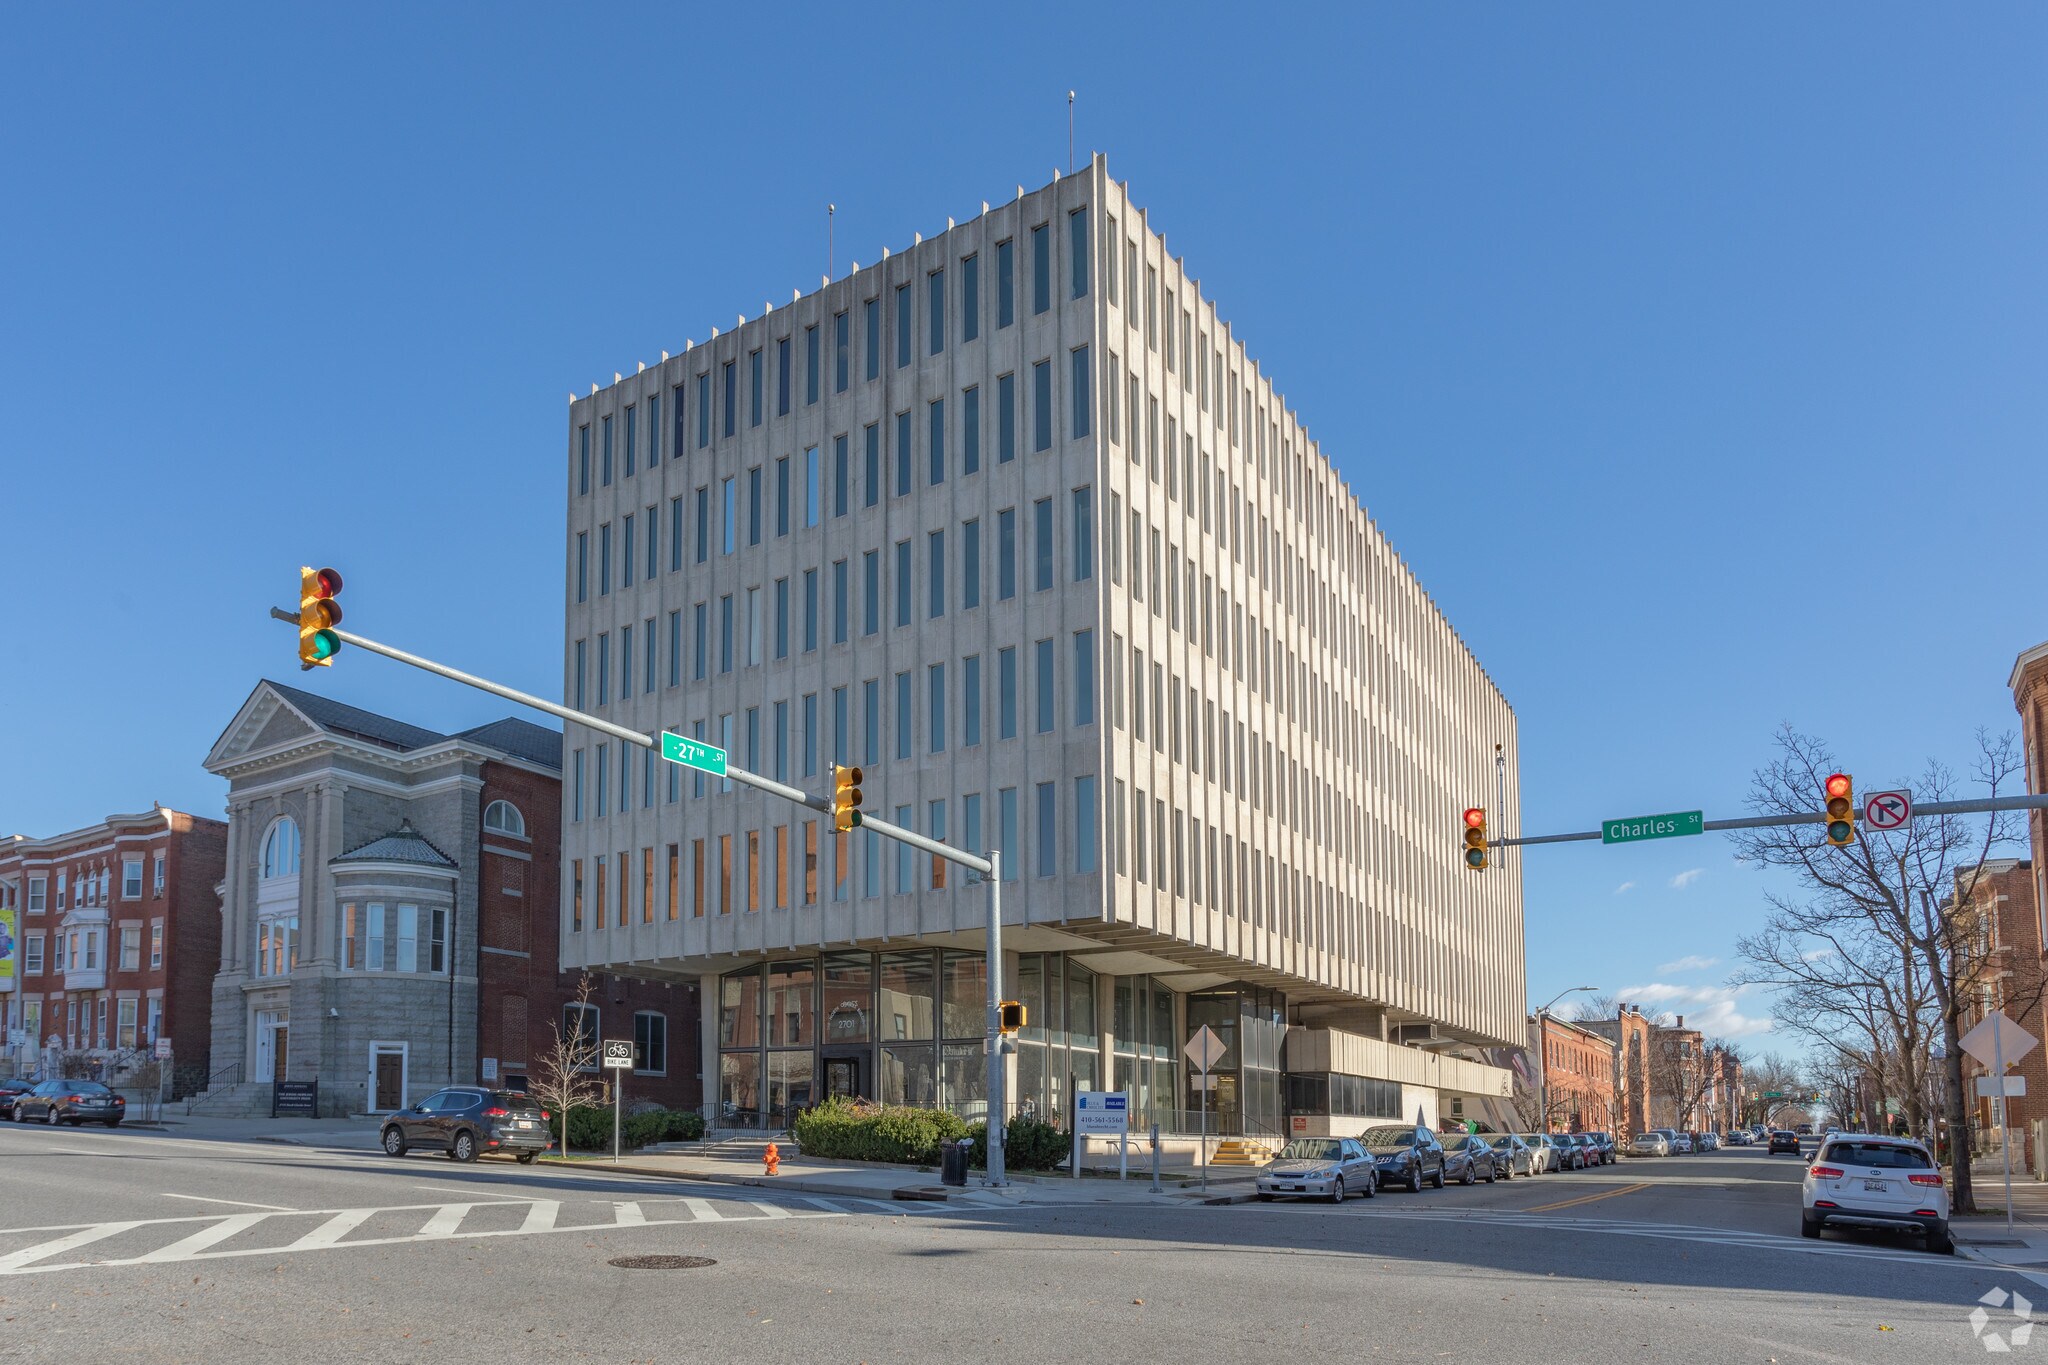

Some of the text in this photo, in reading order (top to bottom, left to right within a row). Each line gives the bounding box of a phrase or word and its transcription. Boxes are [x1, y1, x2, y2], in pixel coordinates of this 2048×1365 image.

[1610, 815, 1699, 839] Charles St
[838, 1019, 855, 1029] 2701
